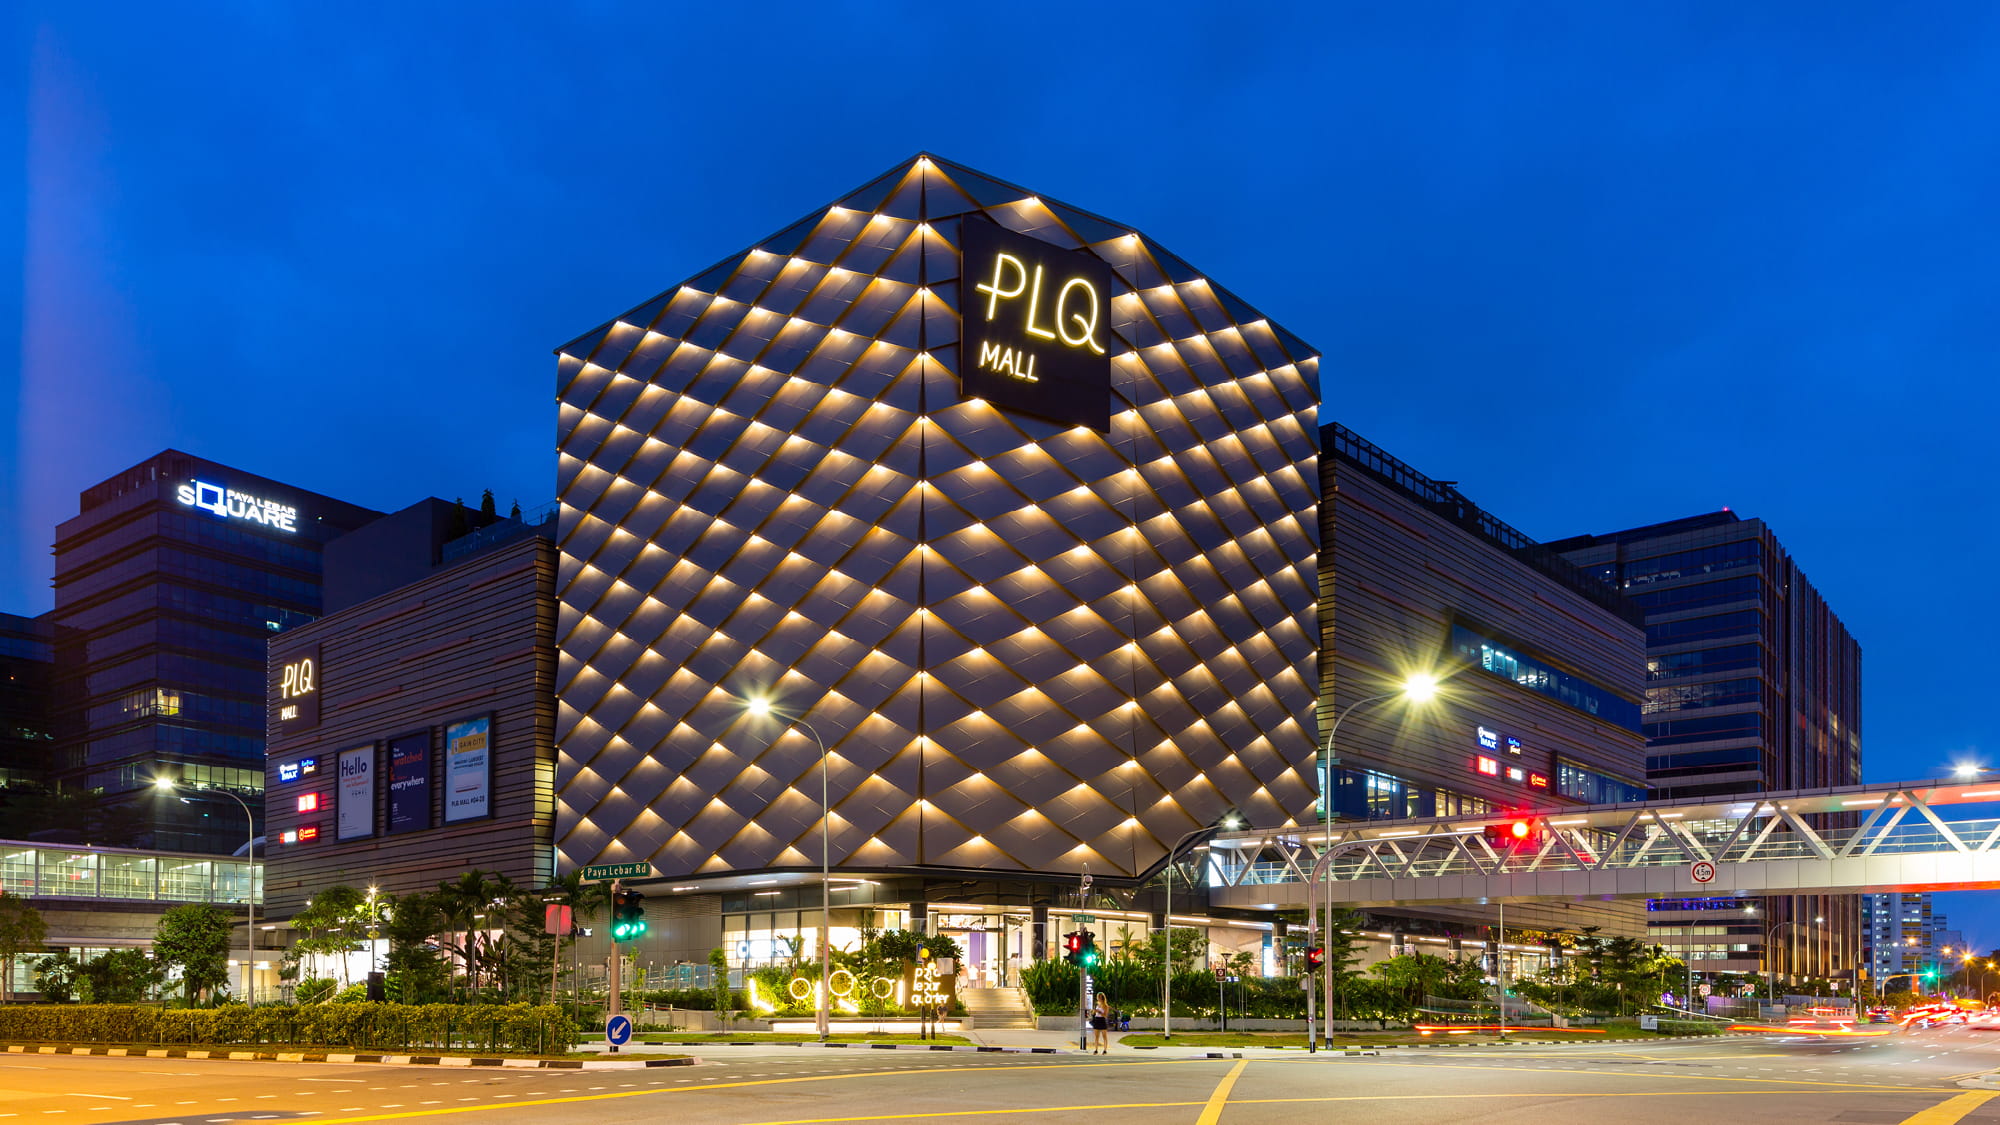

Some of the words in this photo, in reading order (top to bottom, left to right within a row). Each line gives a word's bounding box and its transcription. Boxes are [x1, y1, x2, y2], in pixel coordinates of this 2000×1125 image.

[975, 253, 1106, 356] PLQ
[978, 341, 1040, 384] MALL
[226, 488, 255, 506] PAYA
[257, 497, 297, 517] LEBAR
[280, 658, 315, 699] PLQ
[281, 704, 298, 721] MALL
[341, 756, 368, 778] Hello
[390, 775, 425, 791] everywhere
[587, 867, 607, 878] Paya
[609, 865, 633, 876] Lebar
[635, 863, 647, 874] Rd
